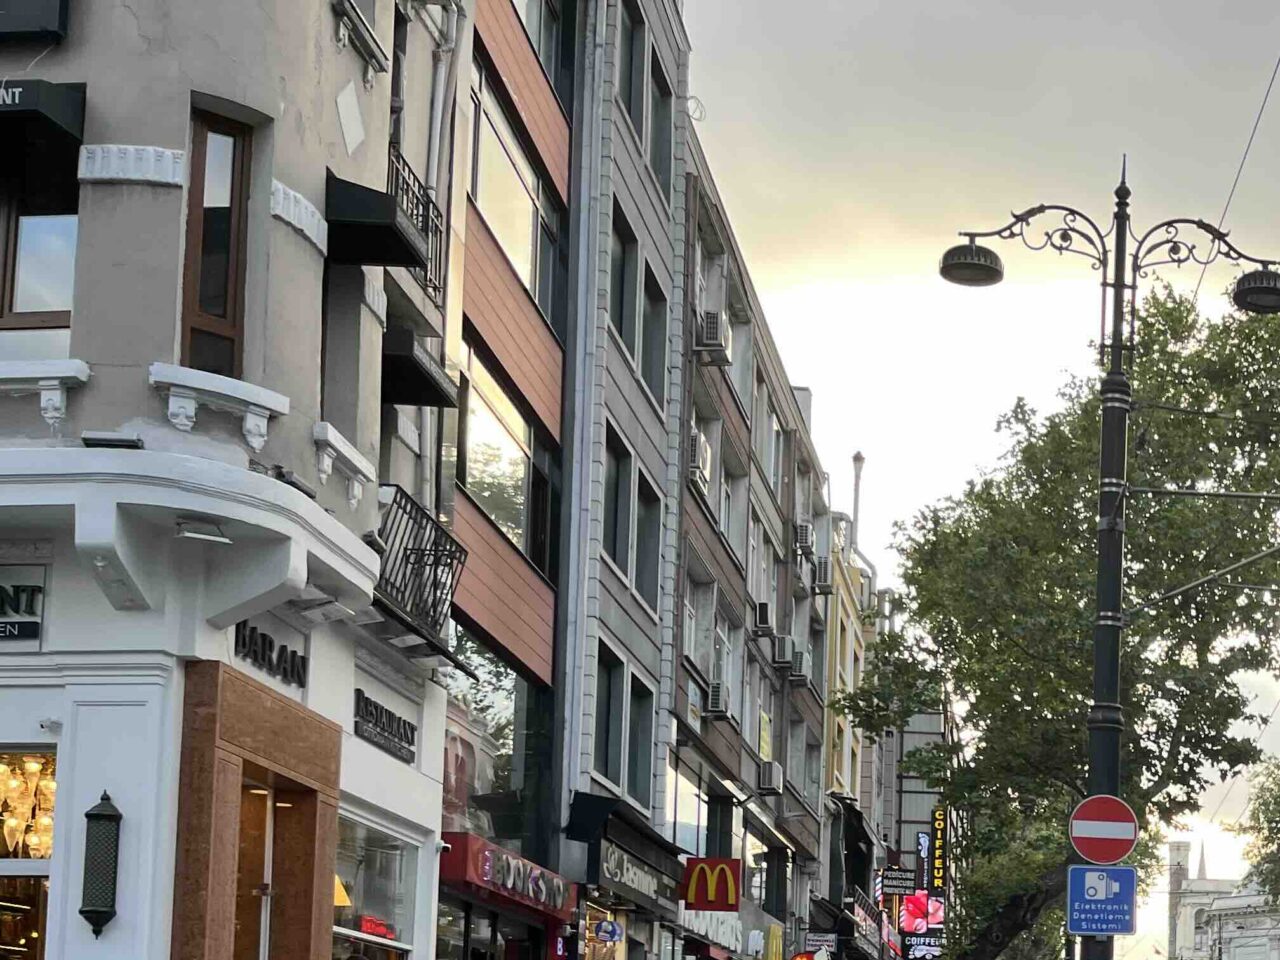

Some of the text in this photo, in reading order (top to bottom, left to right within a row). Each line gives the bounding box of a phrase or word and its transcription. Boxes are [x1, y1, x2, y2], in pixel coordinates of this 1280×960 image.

[354, 688, 417, 747] RESTAURANT
[934, 810, 944, 887] COIFFEUR
[620, 852, 659, 900] Jasmine
[1073, 912, 1130, 920] Denetleme
[1074, 902, 1129, 911] Elektronik
[1081, 921, 1121, 930] Sistemi
